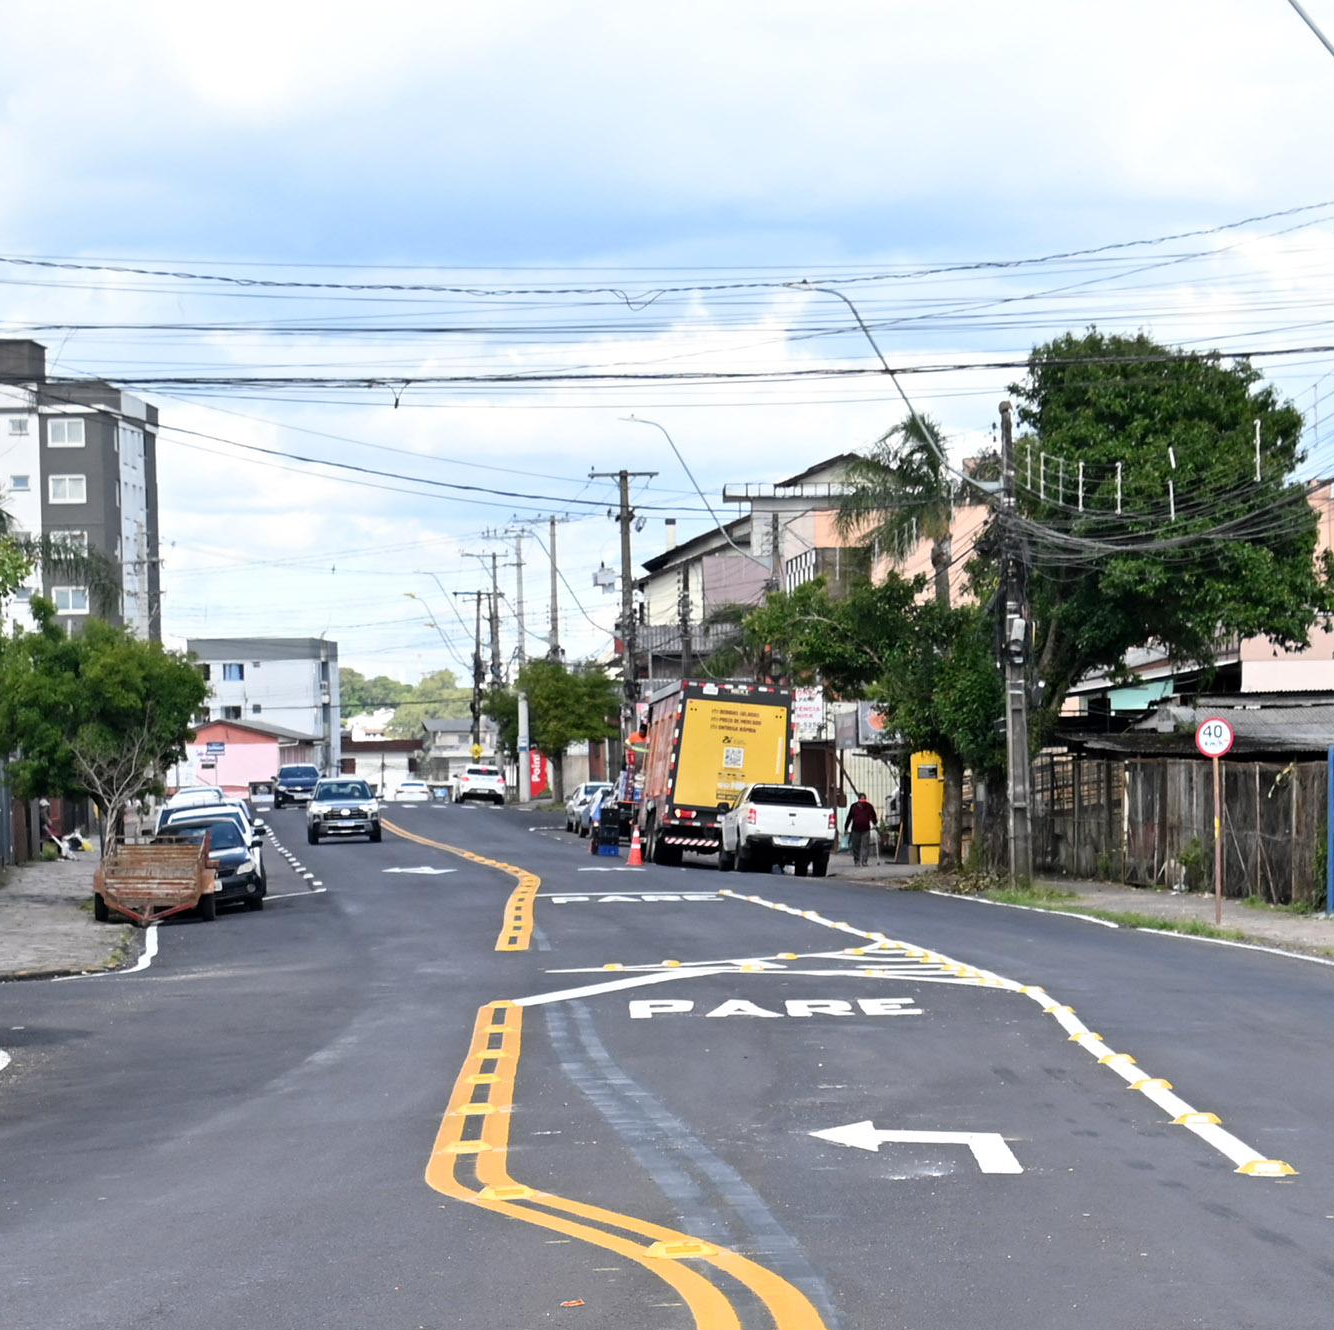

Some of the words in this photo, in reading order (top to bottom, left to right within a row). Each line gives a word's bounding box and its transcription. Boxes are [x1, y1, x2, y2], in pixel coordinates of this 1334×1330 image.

[1203, 725, 1223, 738] 40
[552, 895, 724, 904] PARE
[629, 997, 923, 1019] PARE
